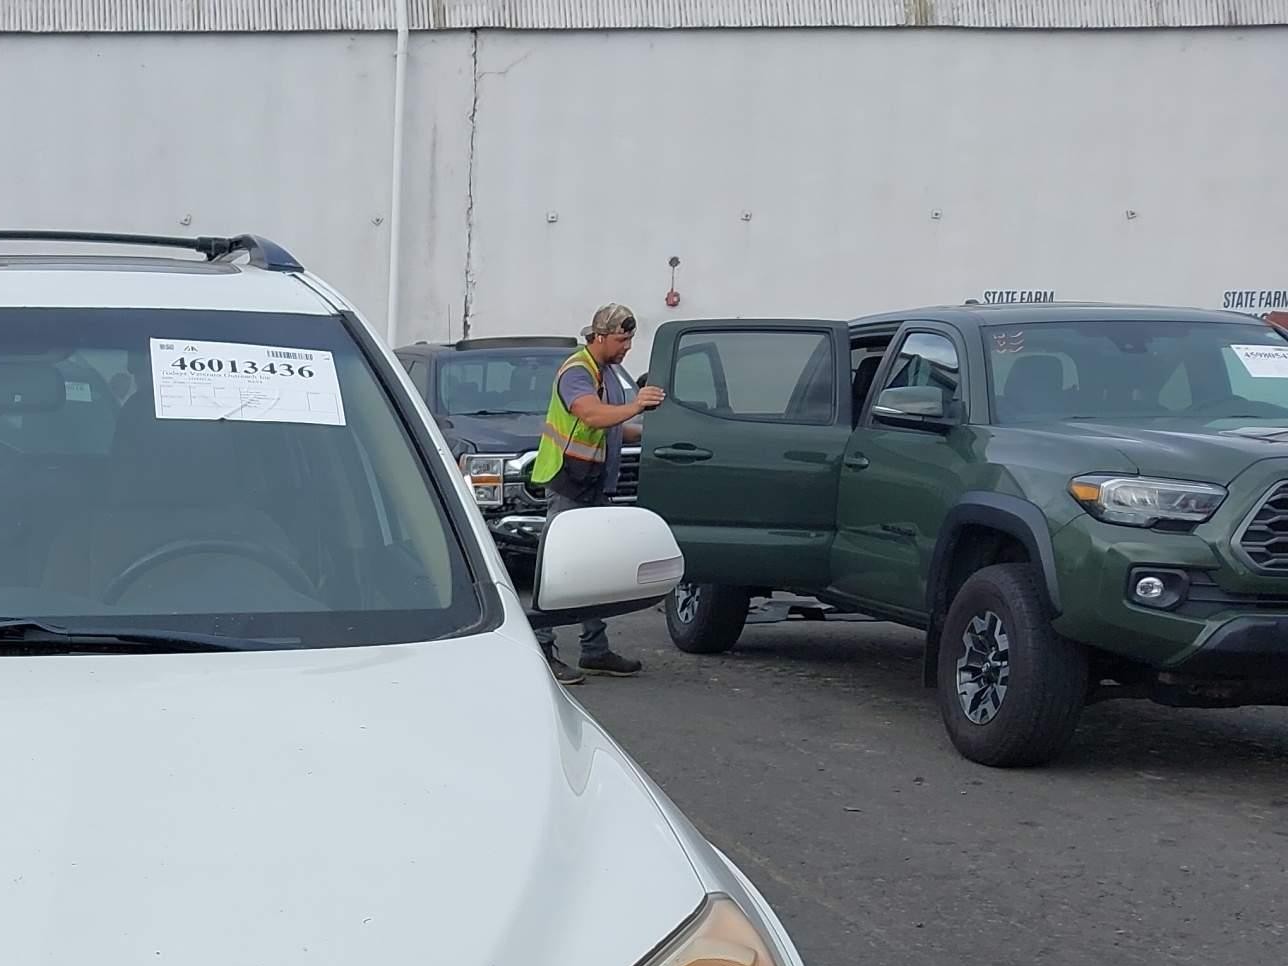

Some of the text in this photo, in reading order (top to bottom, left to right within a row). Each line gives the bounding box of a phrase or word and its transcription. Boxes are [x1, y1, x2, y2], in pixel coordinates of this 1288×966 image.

[984, 291, 1054, 304] STATE FARM
[1223, 291, 1256, 308] STATE
[171, 356, 314, 378] 46013436
